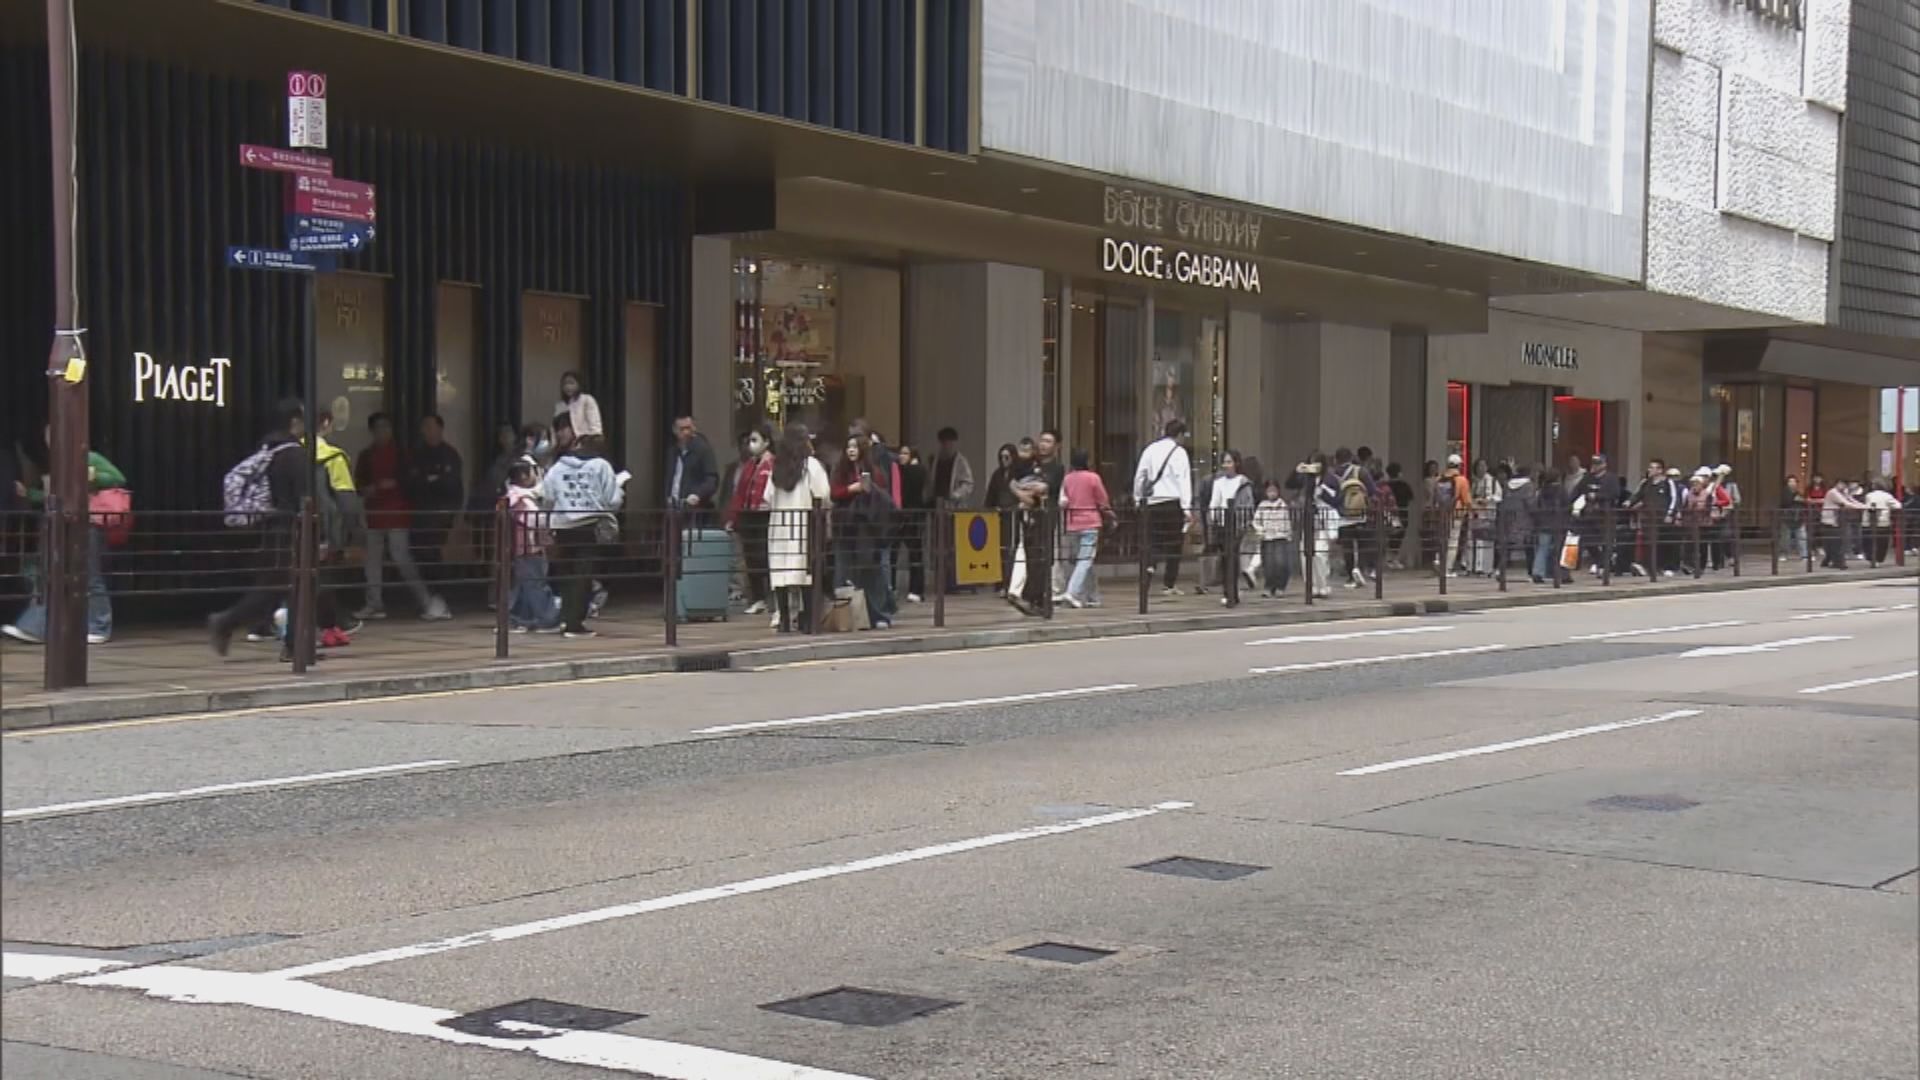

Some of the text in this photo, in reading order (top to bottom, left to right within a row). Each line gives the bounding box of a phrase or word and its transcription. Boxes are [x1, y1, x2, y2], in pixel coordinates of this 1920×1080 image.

[1103, 238, 1163, 279] DOLCE
[1175, 250, 1261, 294] GABBANA
[134, 352, 231, 407] PIAGET
[1522, 342, 1578, 371] MONCLER
